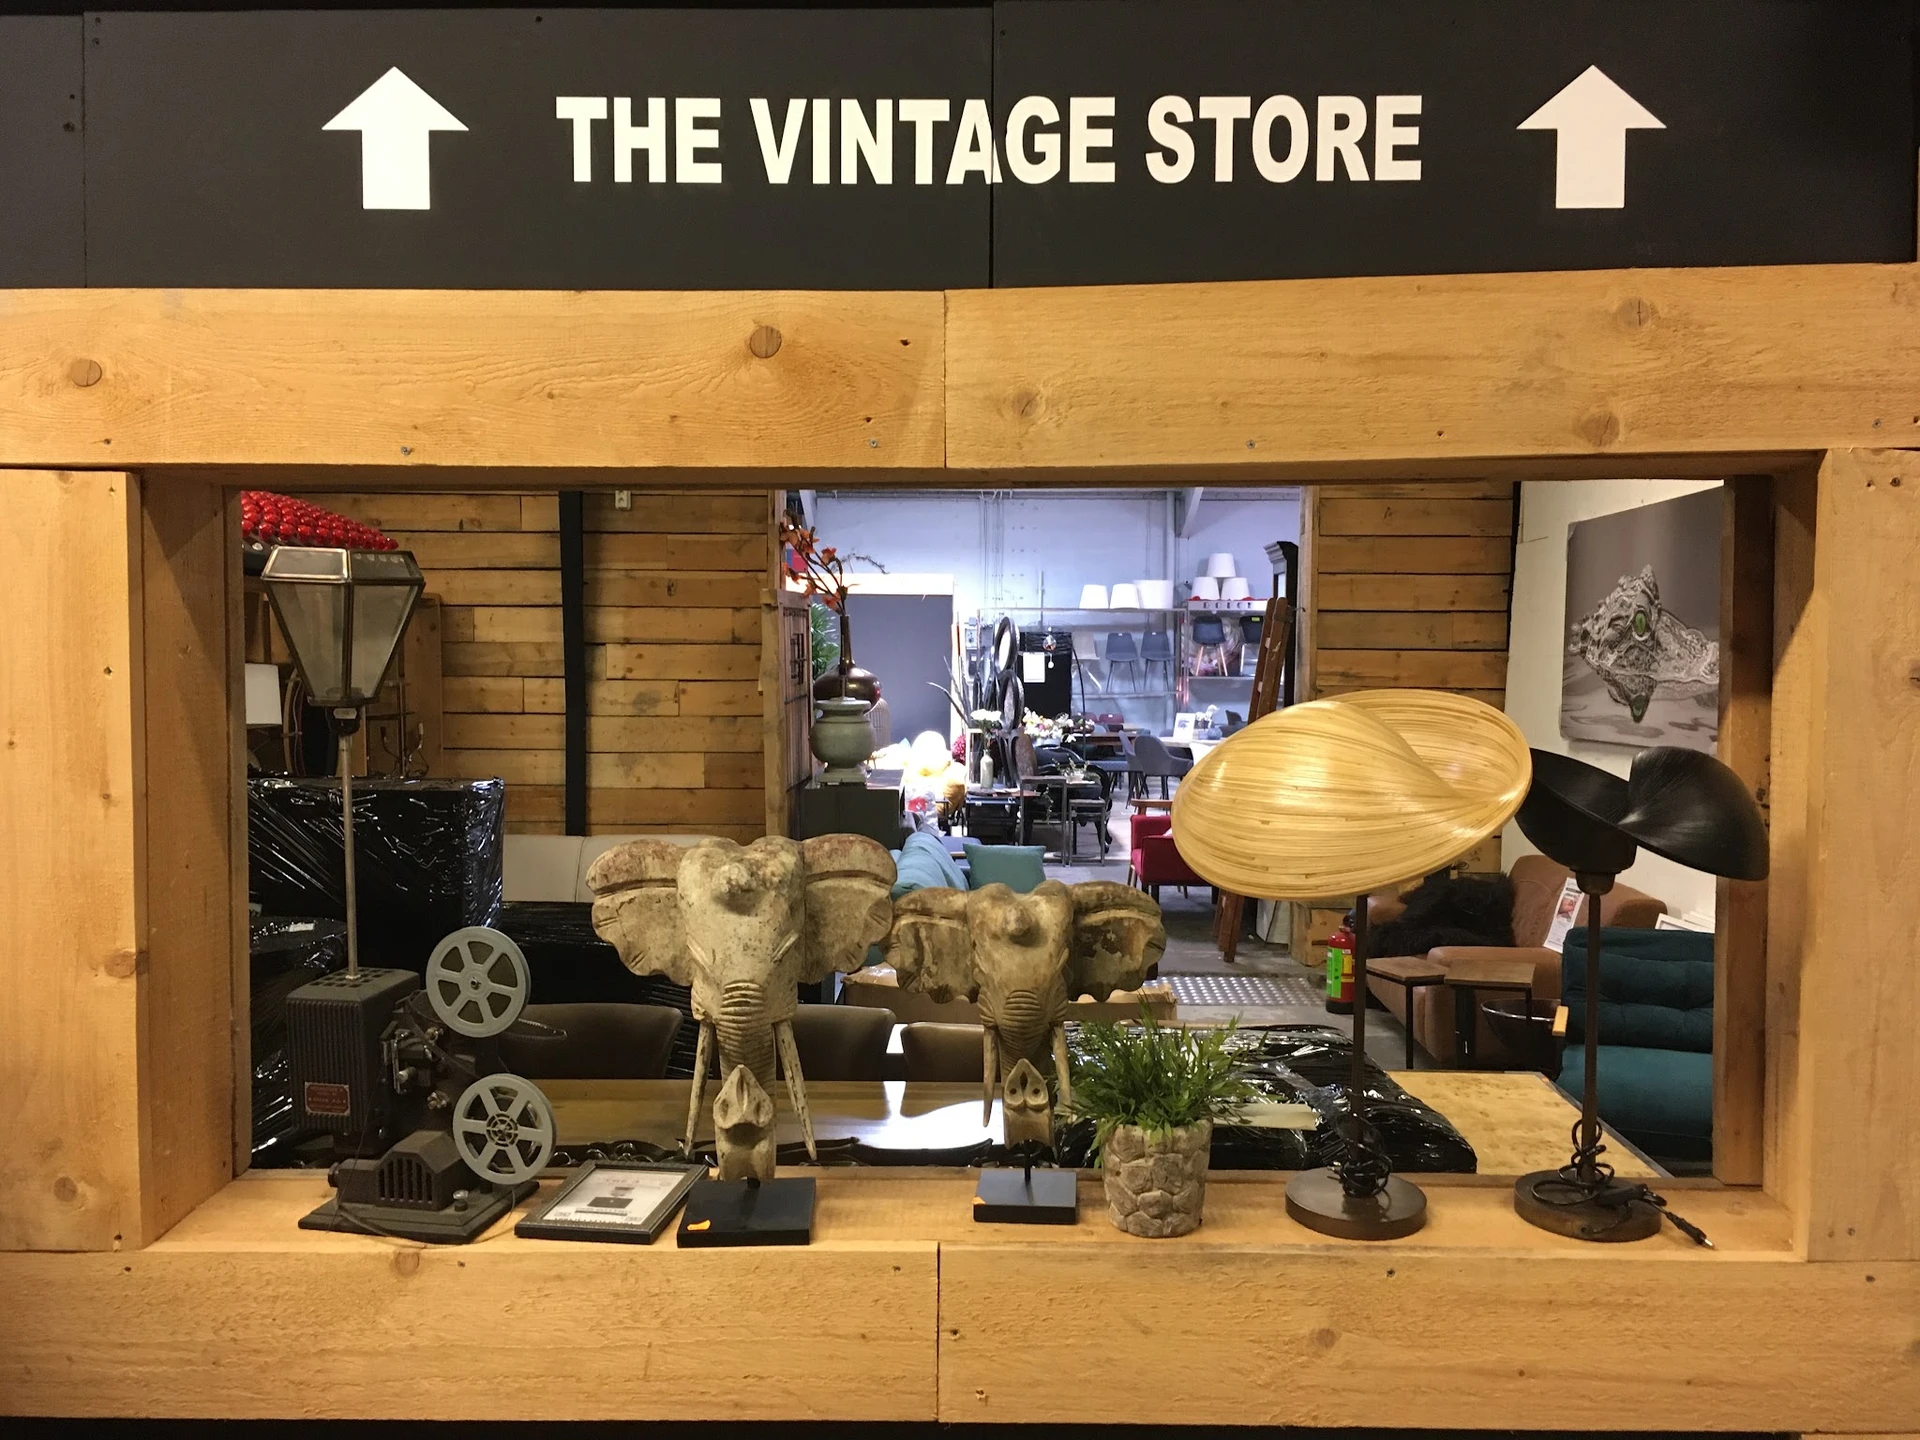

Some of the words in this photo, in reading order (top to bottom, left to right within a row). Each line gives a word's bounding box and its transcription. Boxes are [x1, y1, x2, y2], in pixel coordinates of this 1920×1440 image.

[555, 96, 723, 184] THE
[749, 96, 1117, 185] VINTAGE
[1145, 95, 1423, 184] STORE
